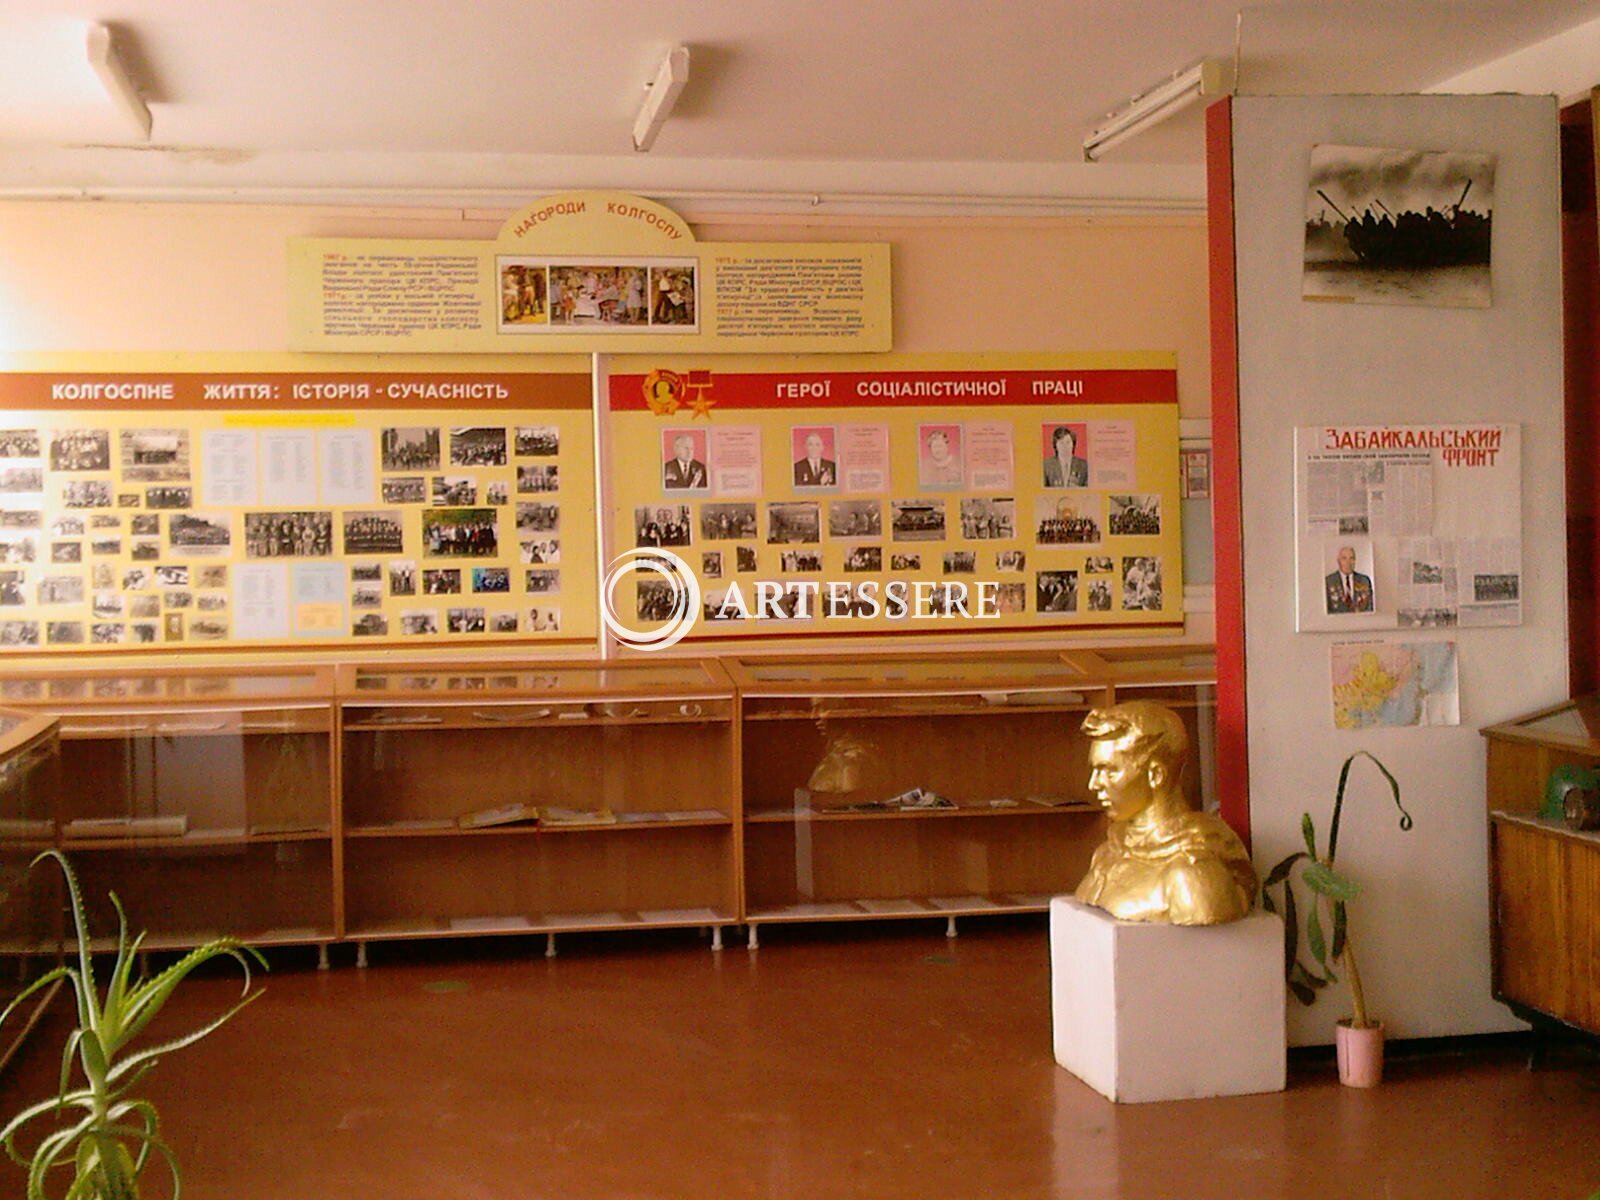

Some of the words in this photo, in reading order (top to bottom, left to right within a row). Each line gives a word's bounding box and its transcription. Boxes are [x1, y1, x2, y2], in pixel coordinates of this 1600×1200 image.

[514, 201, 586, 238] НАГОРОДИ
[607, 202, 682, 240] КОЛГОСПУ
[52, 383, 174, 400] КОЛГОСПНЕ
[203, 383, 279, 400] ЖИТТЯ:
[292, 383, 370, 399] ІСТОРІЯ
[387, 383, 509, 399] СУЧАСНІСТЬ
[776, 380, 831, 398] ГЕРОЇ
[856, 378, 1007, 398] СОЦІАЛІСТИЧНОЇ
[1032, 380, 1084, 397] ПРАЦІ
[1325, 427, 1501, 450] ЗАБАЙКАЛЬСЬКИЙ
[1442, 449, 1500, 467] ФРОНТ
